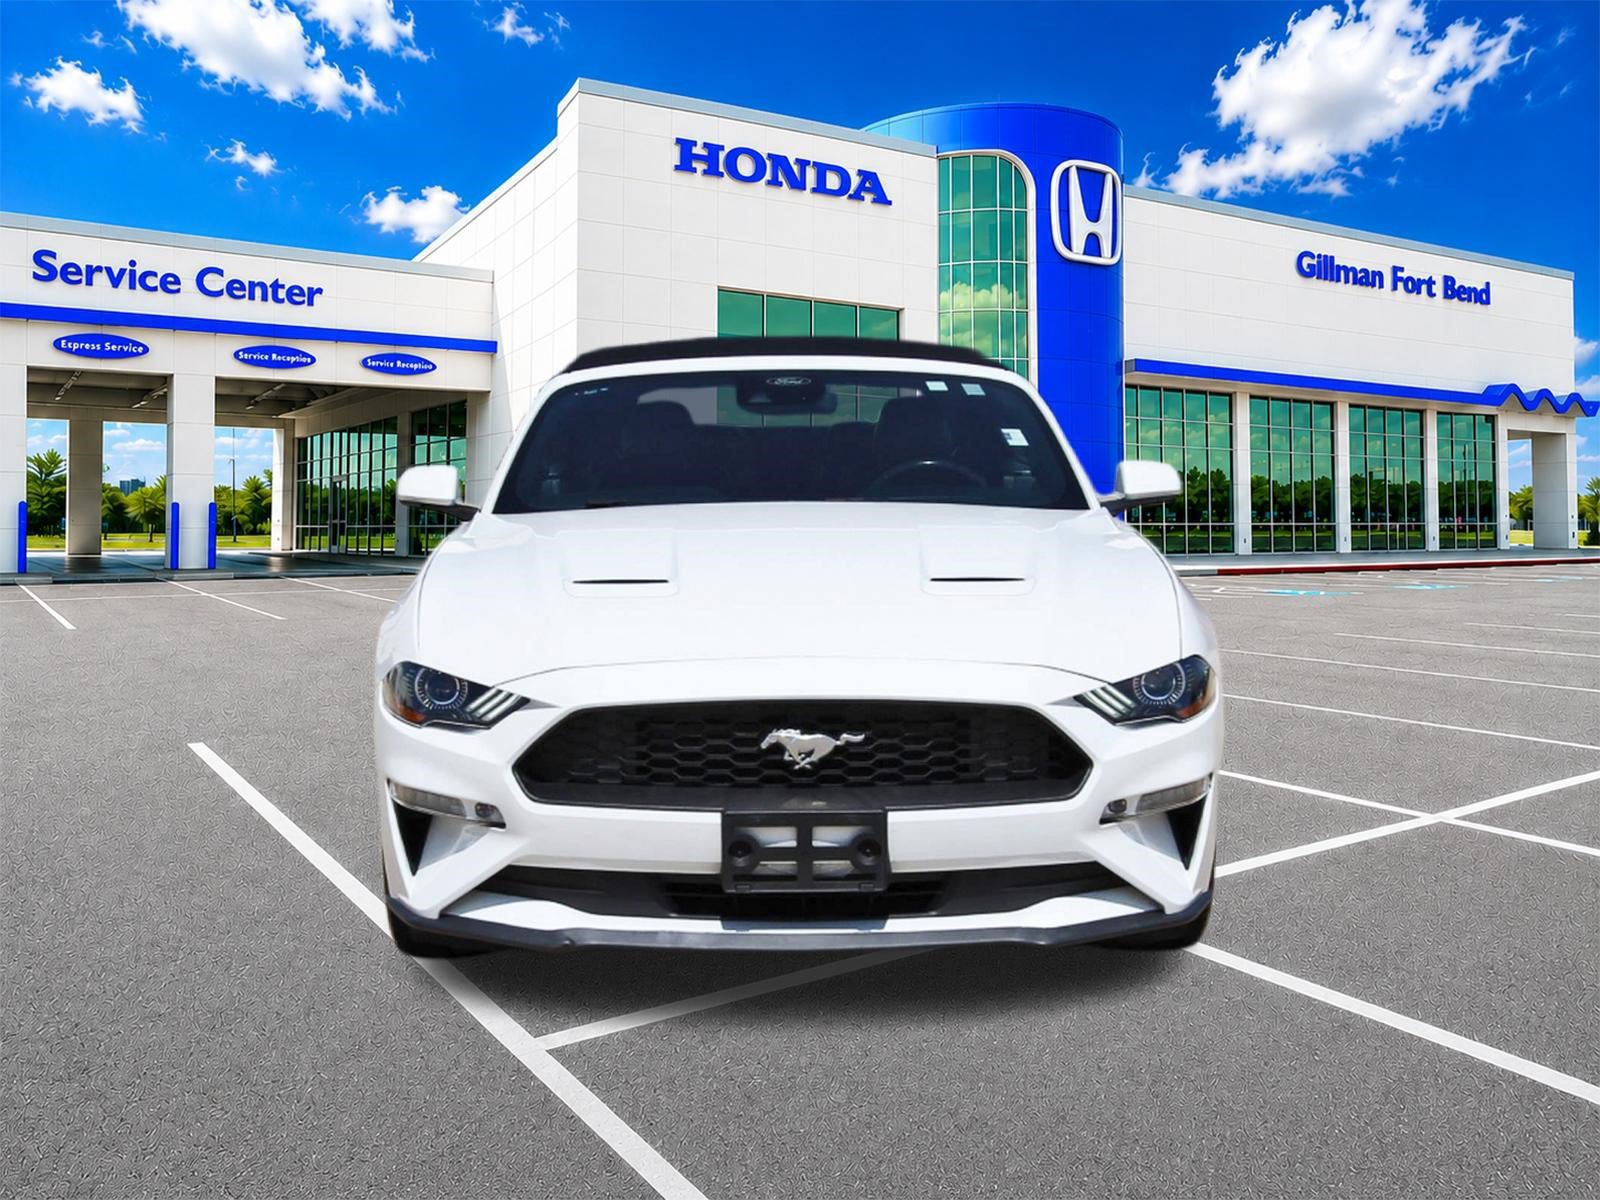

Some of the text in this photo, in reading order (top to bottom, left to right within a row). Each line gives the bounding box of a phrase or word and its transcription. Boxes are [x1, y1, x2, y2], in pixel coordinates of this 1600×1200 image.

[674, 137, 892, 205] HONDA
[32, 249, 323, 306] Service Center
[1296, 250, 1491, 305] Gillman Fort Bend
[61, 339, 144, 353] Express Service
[238, 351, 311, 364] Service Reception
[367, 358, 394, 368] Service
